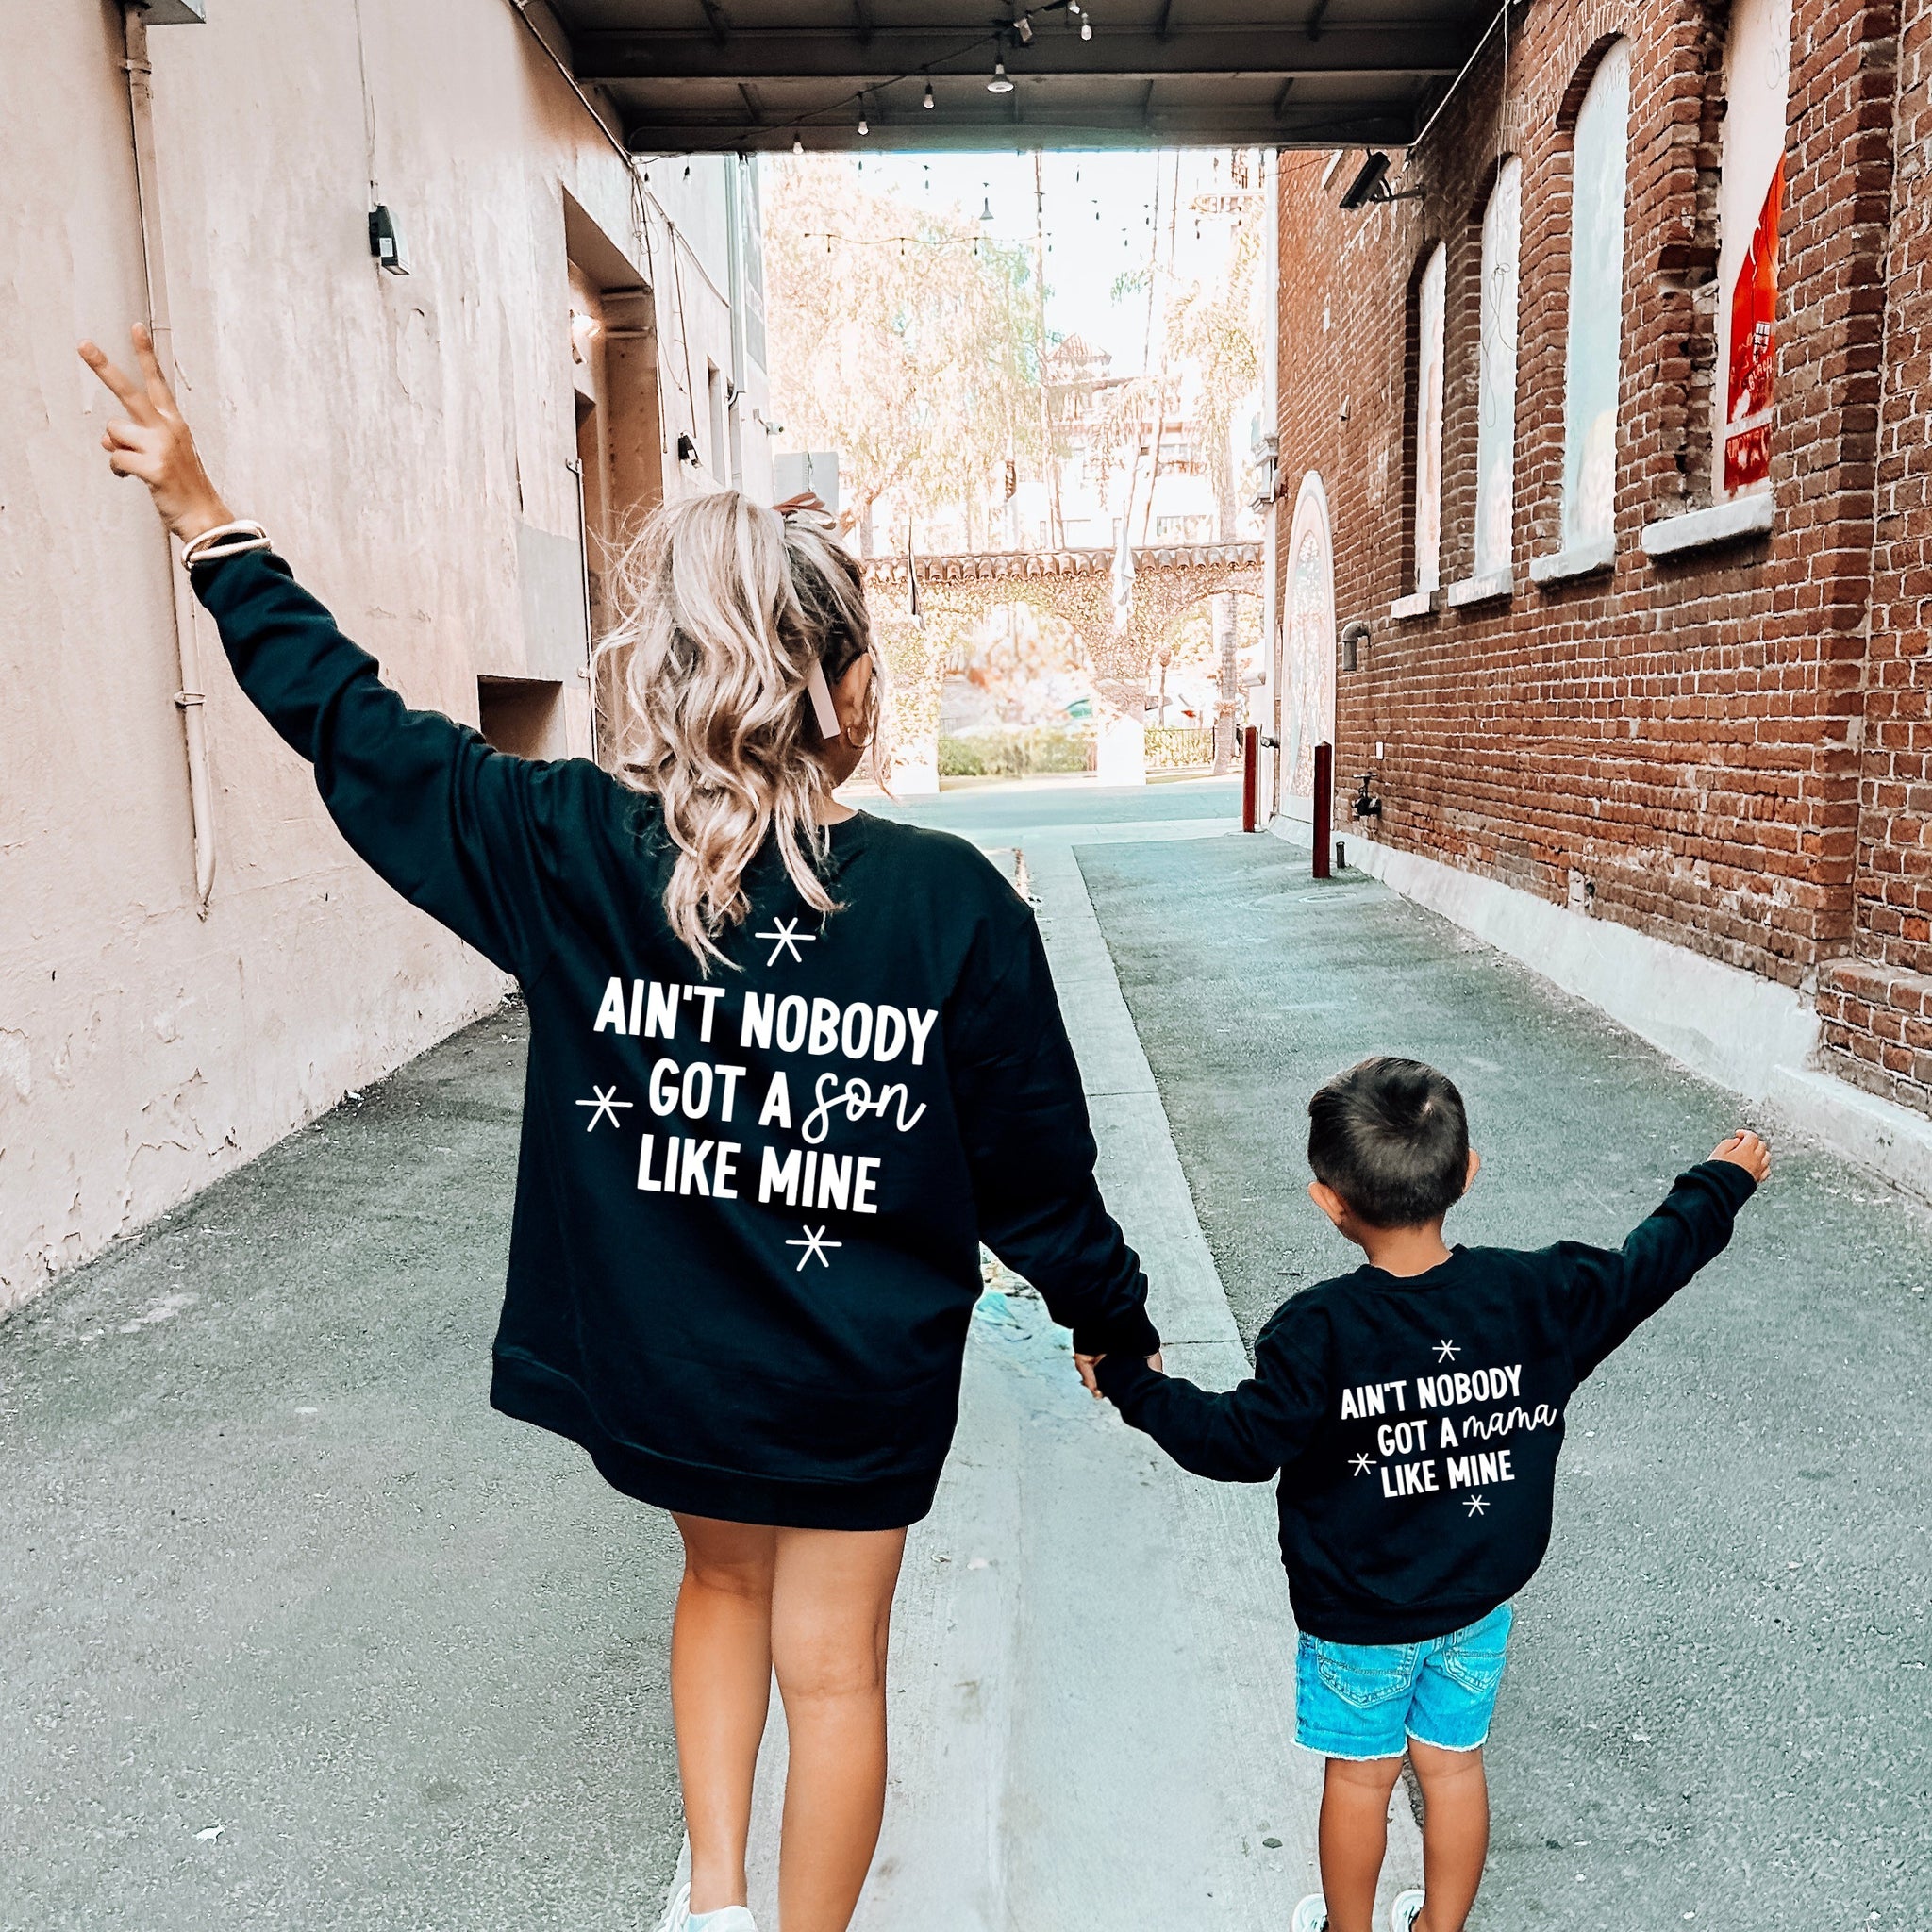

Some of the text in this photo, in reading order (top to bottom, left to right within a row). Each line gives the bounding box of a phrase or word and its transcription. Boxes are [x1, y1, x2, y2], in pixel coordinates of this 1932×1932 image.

[592, 976, 939, 1066] AIN'T NOBODY
[648, 1058, 927, 1145] GOT A son
[637, 1133, 881, 1214] LIKE MINE
[1341, 1364, 1522, 1421] AIN'T NOBODY
[1377, 1403, 1557, 1457] GOT A mama
[1380, 1449, 1516, 1499] LIKE MINE
